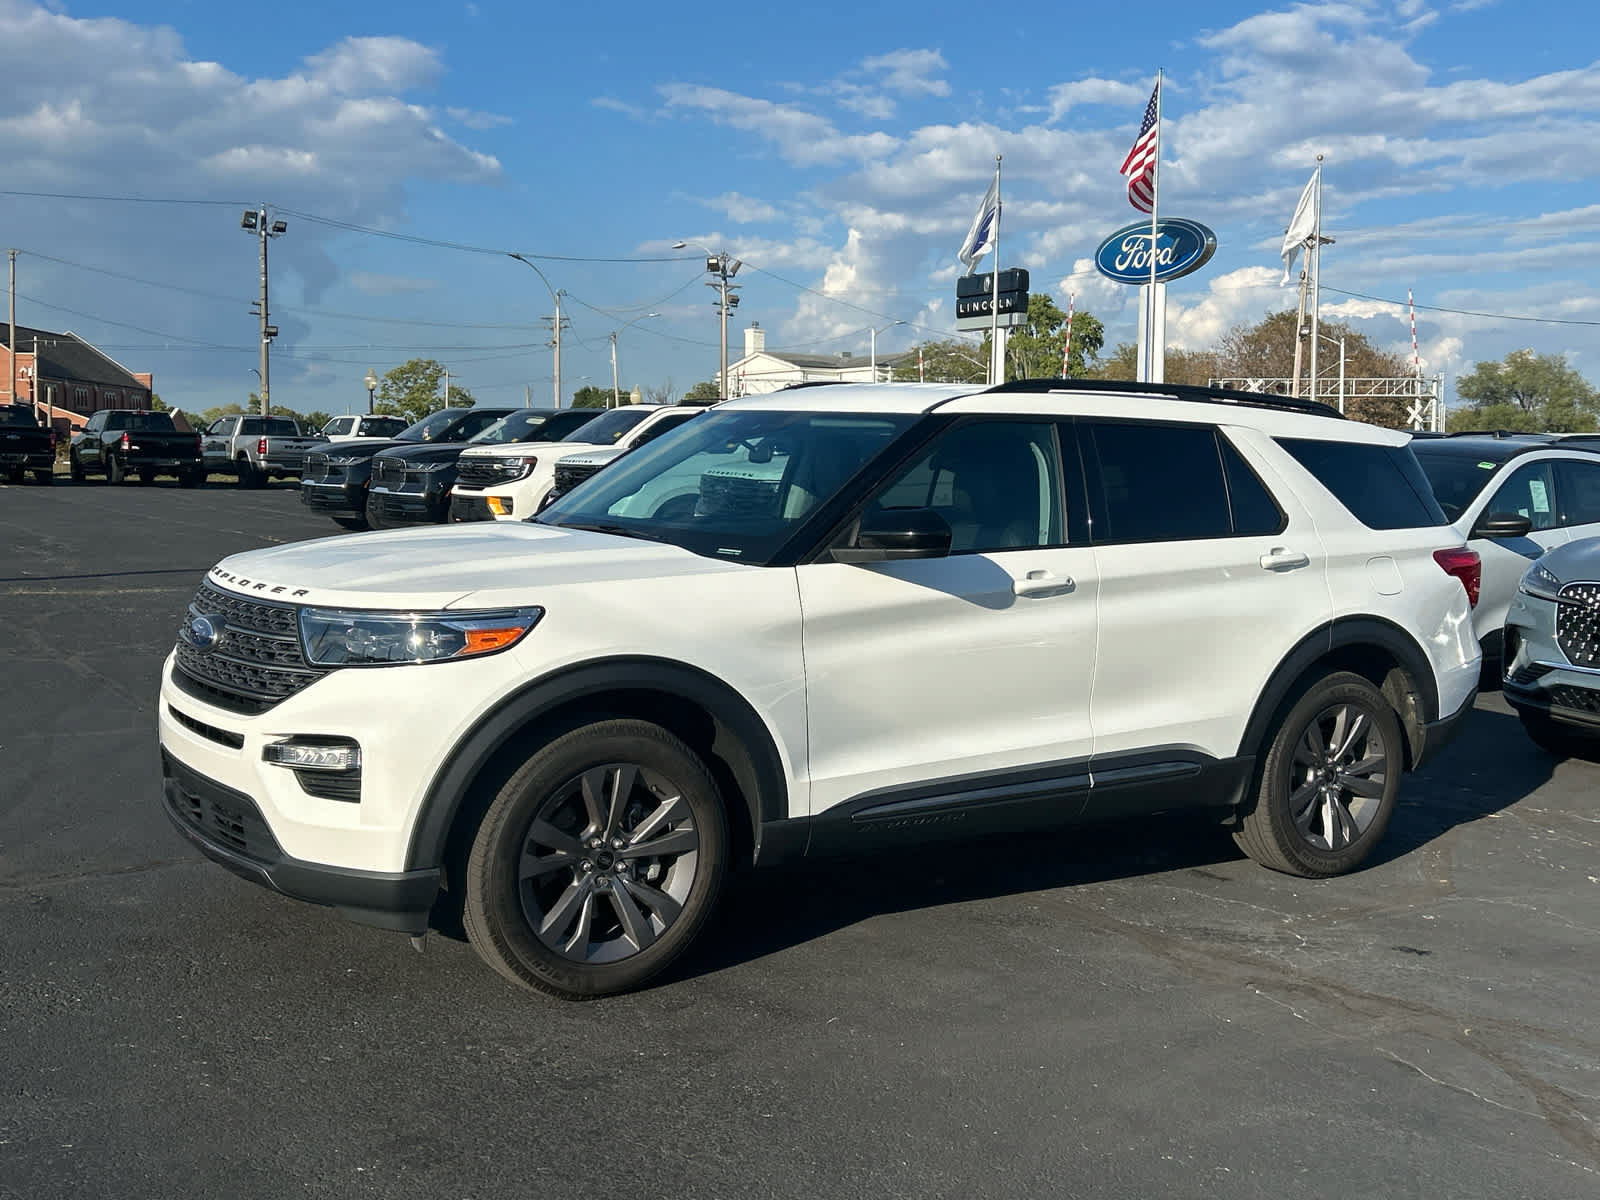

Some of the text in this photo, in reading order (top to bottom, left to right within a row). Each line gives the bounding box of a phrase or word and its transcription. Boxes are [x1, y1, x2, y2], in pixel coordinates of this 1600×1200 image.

[1115, 232, 1180, 271] Ford
[960, 298, 1012, 313] LINCOLN
[211, 566, 310, 597] EXPLORER
